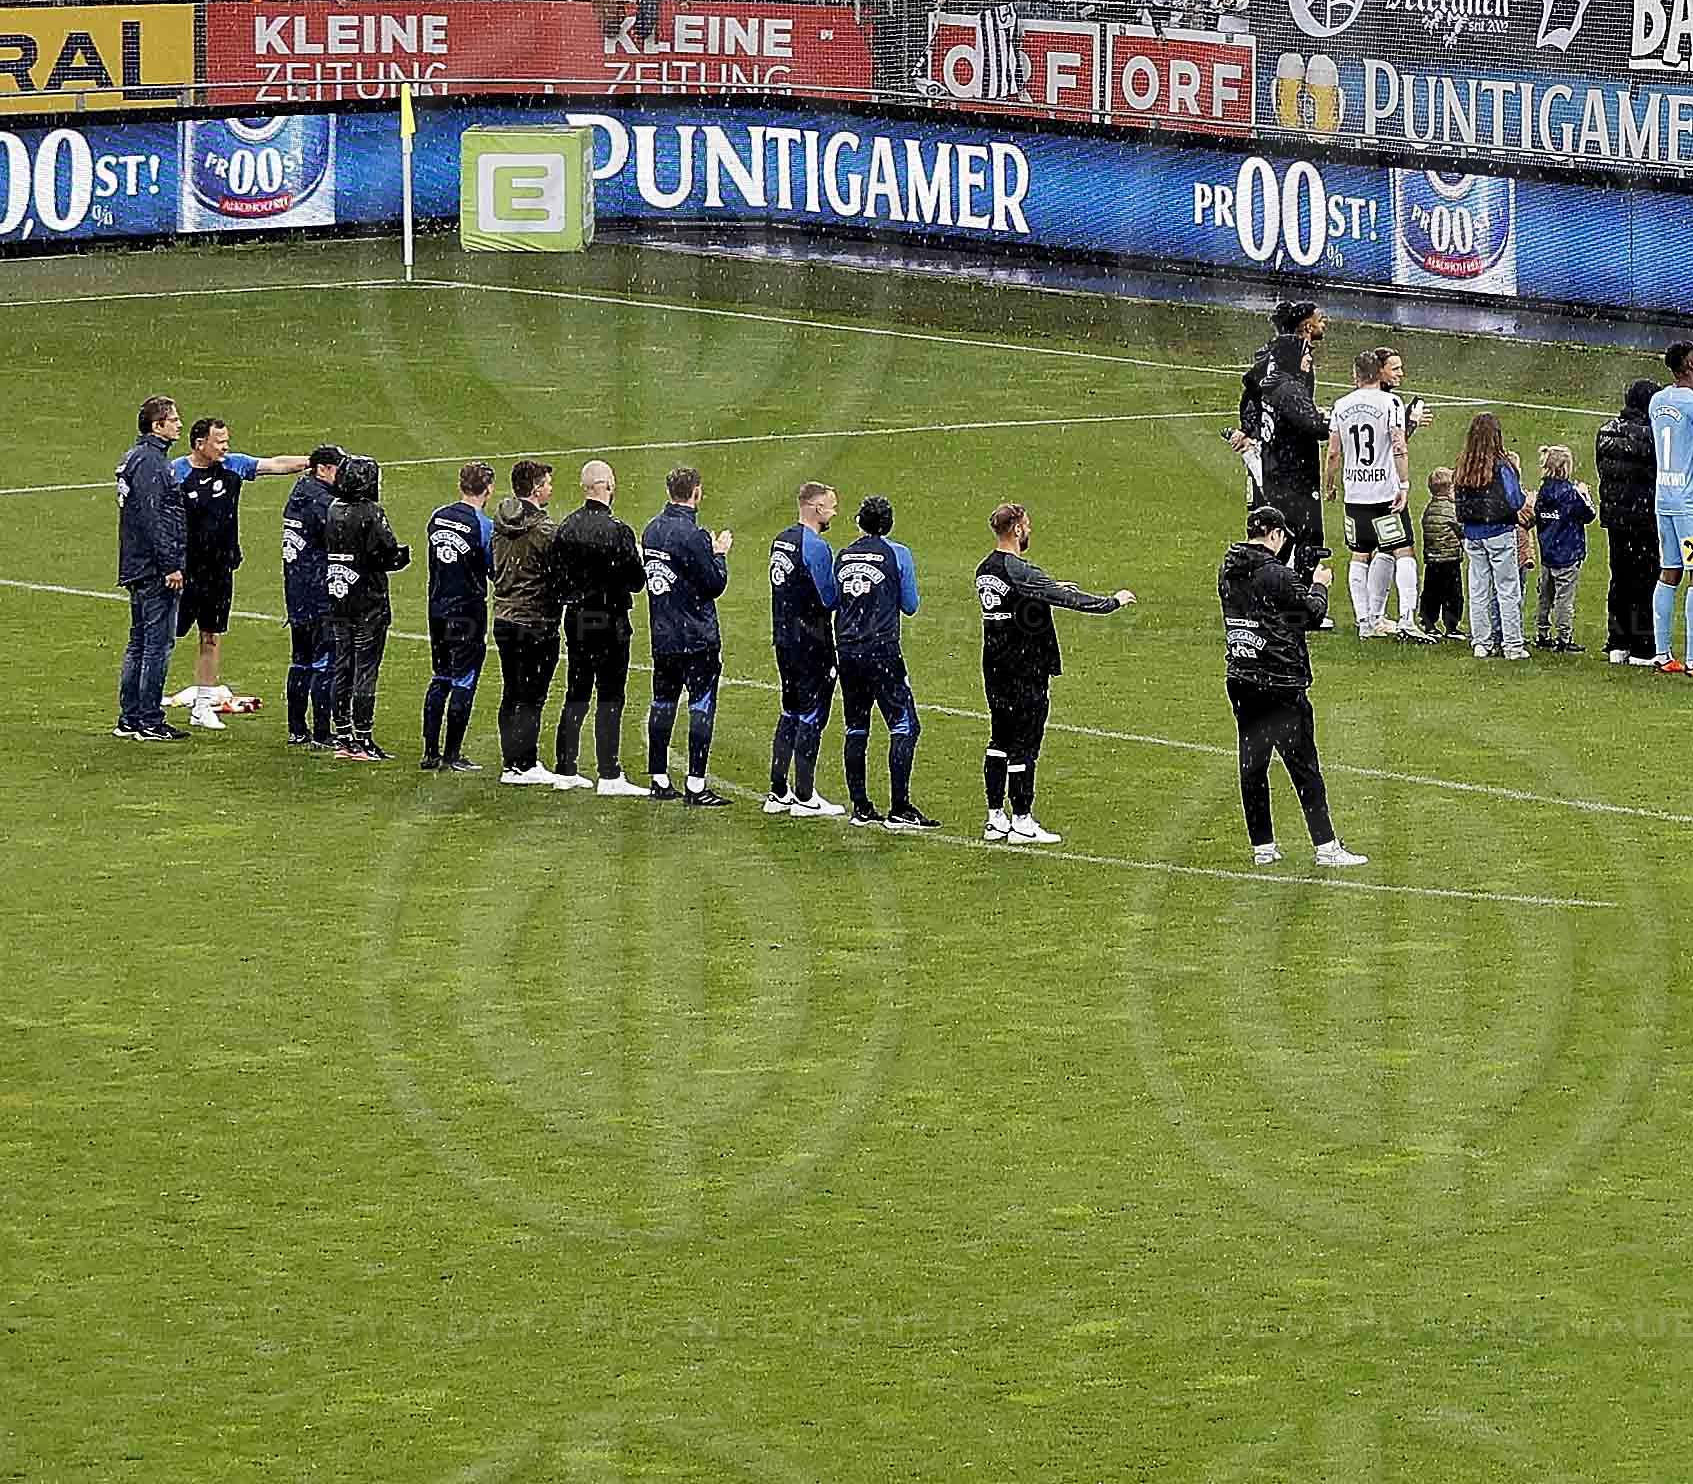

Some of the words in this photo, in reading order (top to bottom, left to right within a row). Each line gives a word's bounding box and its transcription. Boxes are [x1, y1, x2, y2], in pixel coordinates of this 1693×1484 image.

[255, 14, 449, 55] KLEINE
[603, 14, 793, 57] KLEINE
[255, 62, 449, 102] ZEITUNG
[603, 62, 793, 96] ZEITUNG
[1120, 54, 1245, 120] ORF
[566, 112, 1031, 234] PUNTIGAMER
[1349, 423, 1375, 467] 13
[1662, 426, 1672, 471] 1
